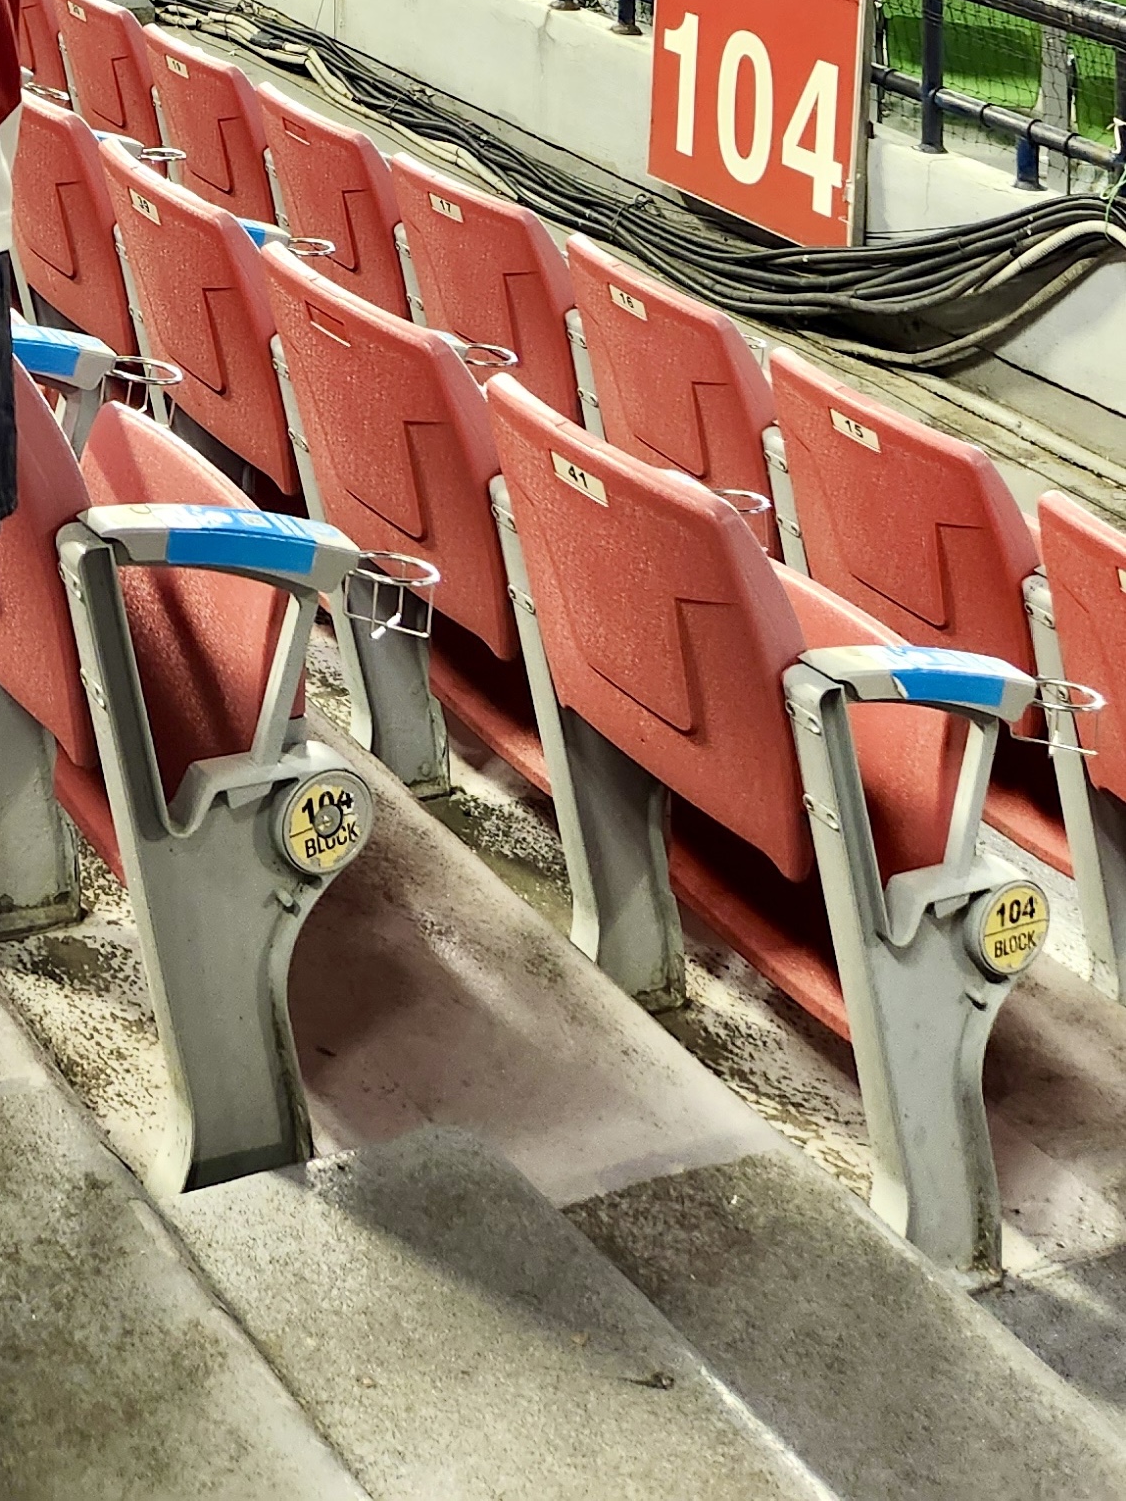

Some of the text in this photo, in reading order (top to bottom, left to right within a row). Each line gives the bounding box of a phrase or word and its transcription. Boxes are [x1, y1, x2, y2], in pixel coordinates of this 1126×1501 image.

[663, 11, 844, 219] 104
[439, 199, 451, 214] 17
[619, 292, 634, 309] 16
[844, 419, 864, 438] 15
[568, 464, 590, 489] 41
[996, 895, 1036, 927] 104
[994, 929, 1038, 959] BLOCK
